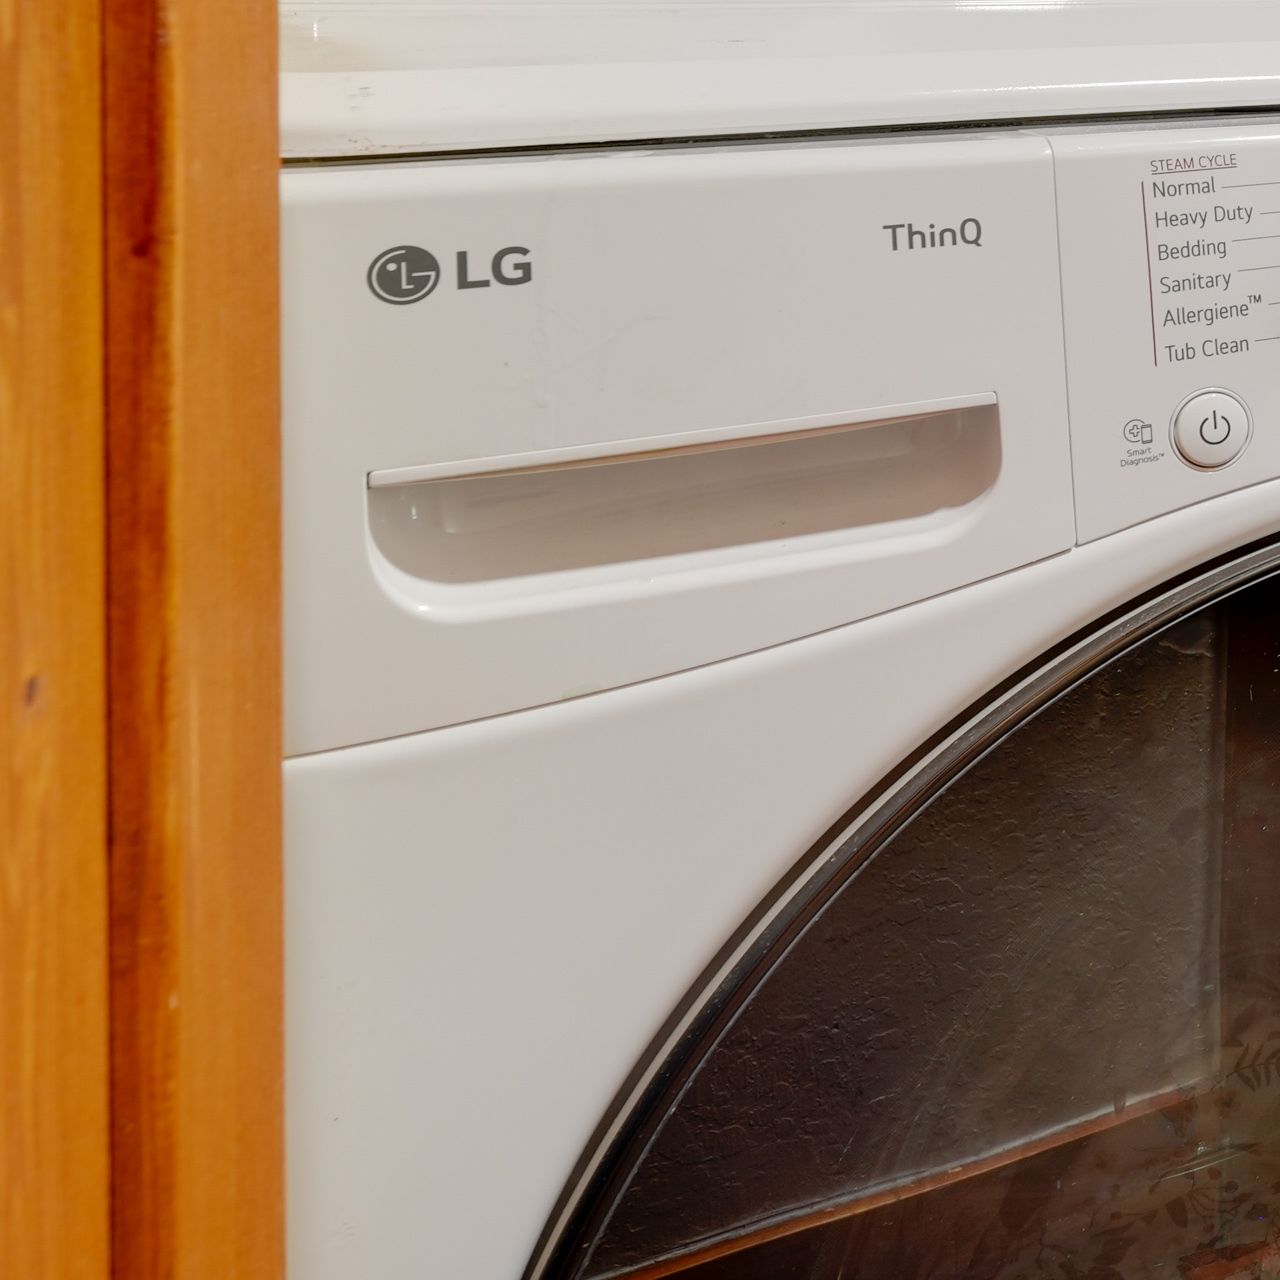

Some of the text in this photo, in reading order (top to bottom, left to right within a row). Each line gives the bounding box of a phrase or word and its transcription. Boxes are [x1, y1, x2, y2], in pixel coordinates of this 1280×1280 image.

[1150, 153, 1238, 173] STEAM CYCLE
[1152, 176, 1216, 198] Normal
[1155, 205, 1253, 229] Heavy Duty
[882, 218, 983, 251] ThinQ
[1157, 239, 1227, 261] Bedding
[456, 246, 533, 290] LG
[1160, 272, 1231, 294] Sanitary
[1164, 338, 1250, 363] Tub Clean
[1126, 447, 1152, 458] Smart
